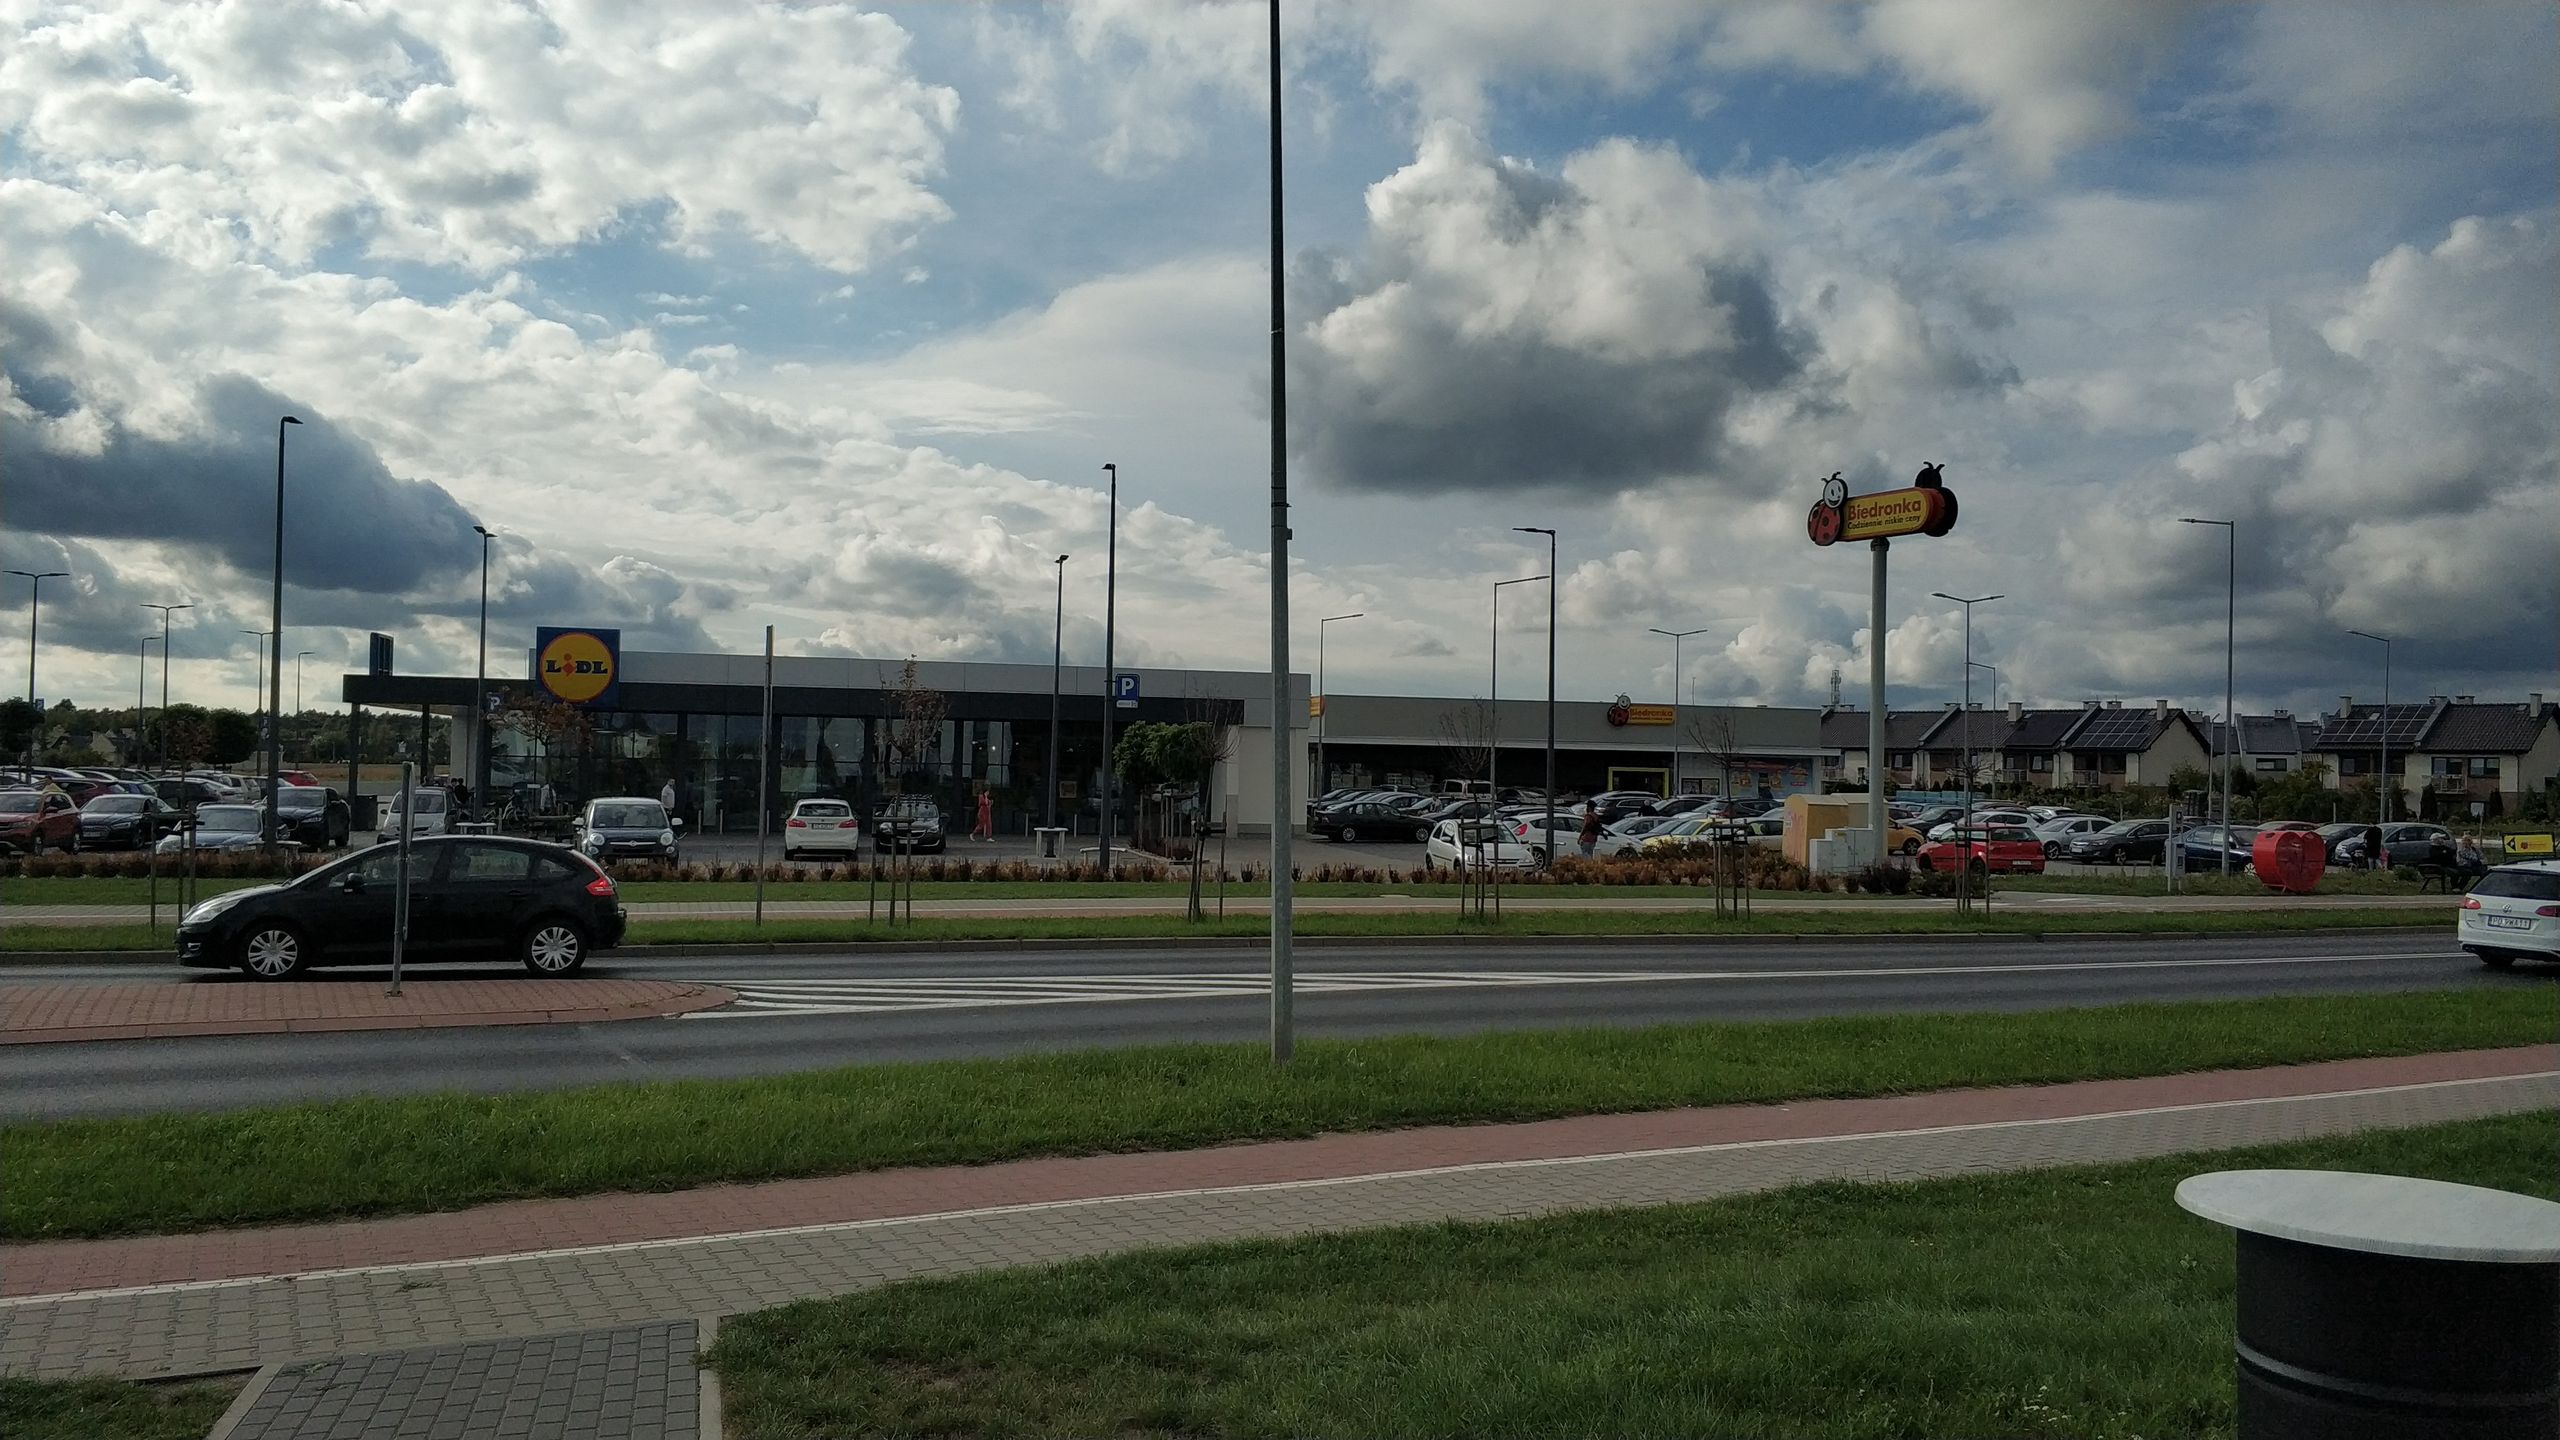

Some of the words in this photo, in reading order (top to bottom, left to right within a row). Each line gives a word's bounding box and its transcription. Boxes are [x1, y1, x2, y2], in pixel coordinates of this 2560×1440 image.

[1847, 498, 1921, 521] Biedronka
[1121, 677, 1135, 696] P
[1630, 707, 1673, 717] Biedronka
